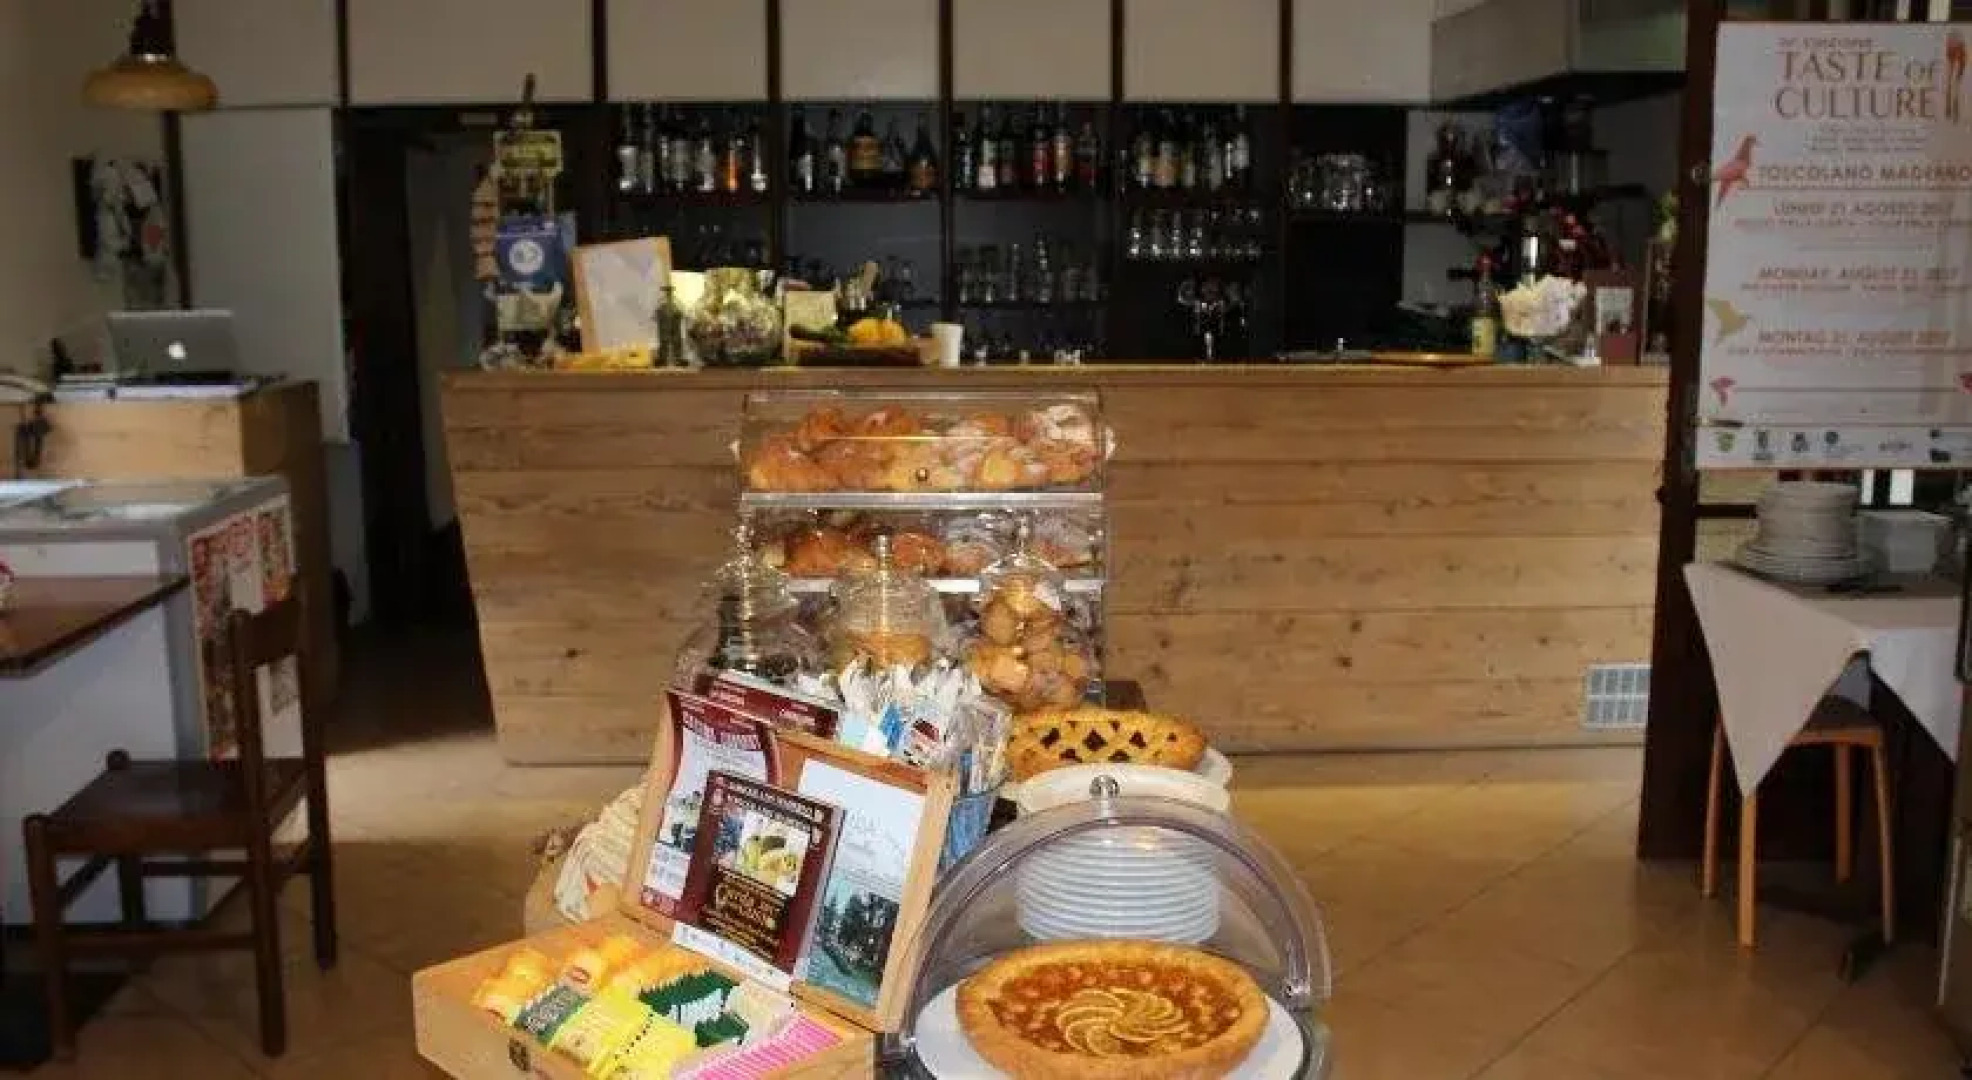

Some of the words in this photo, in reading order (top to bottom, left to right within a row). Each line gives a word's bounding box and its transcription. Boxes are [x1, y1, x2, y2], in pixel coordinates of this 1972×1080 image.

[1776, 50, 1897, 82] TASTE
[1774, 86, 1936, 119] CULTURE
[1759, 164, 1873, 181] TOSCOLANO
[1880, 164, 1972, 181] MADERNO
